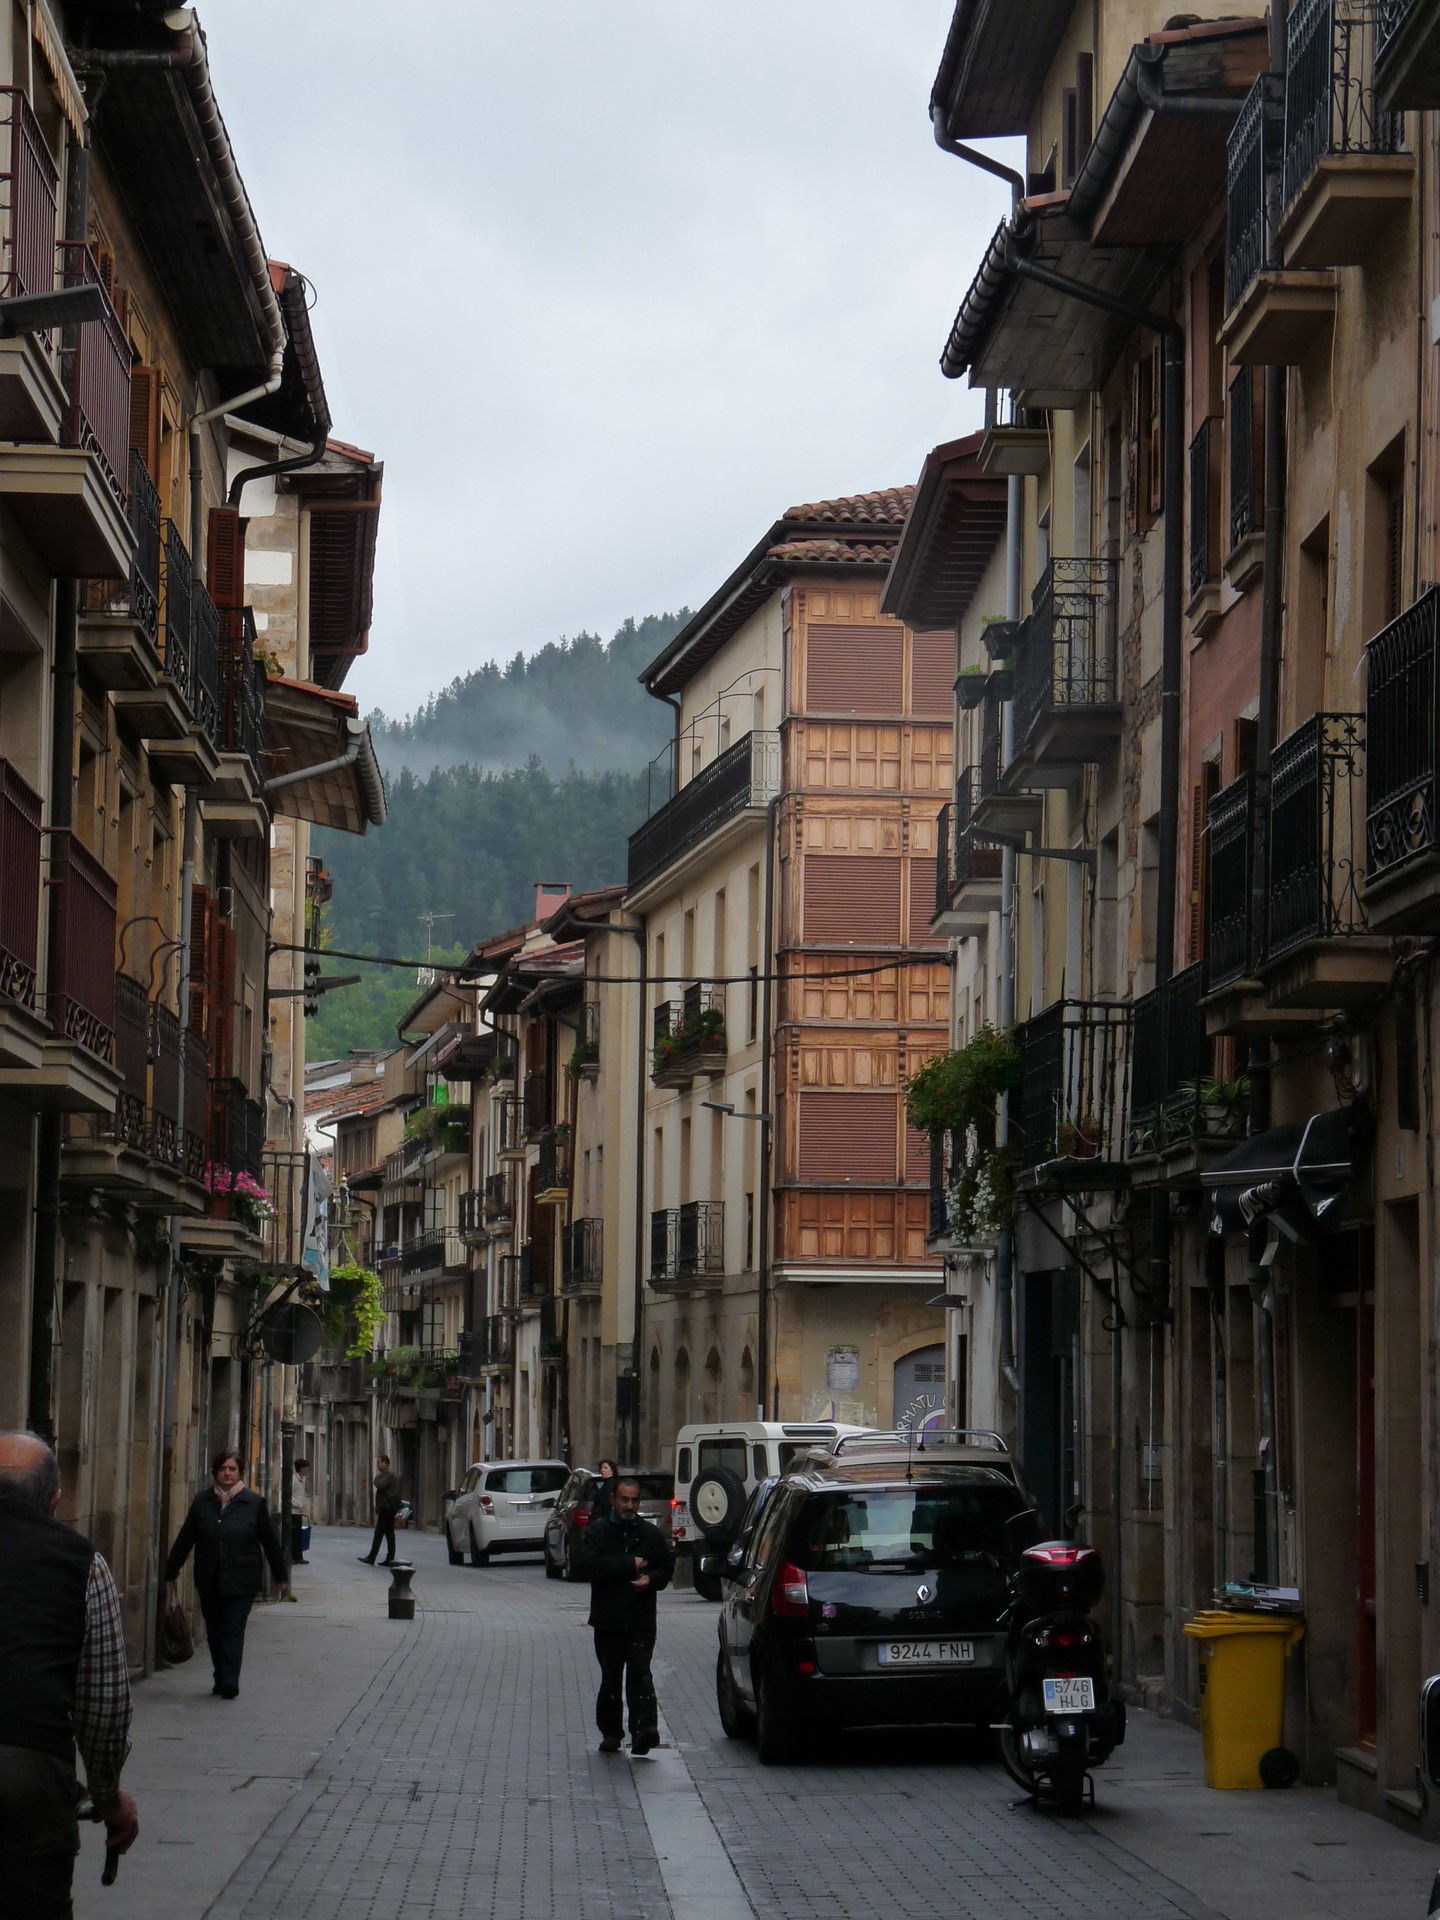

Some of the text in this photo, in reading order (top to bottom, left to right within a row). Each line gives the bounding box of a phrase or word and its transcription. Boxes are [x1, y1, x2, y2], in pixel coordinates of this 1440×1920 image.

[890, 1642, 971, 1660] 9244 FNH
[1054, 1679, 1090, 1694] 5746
